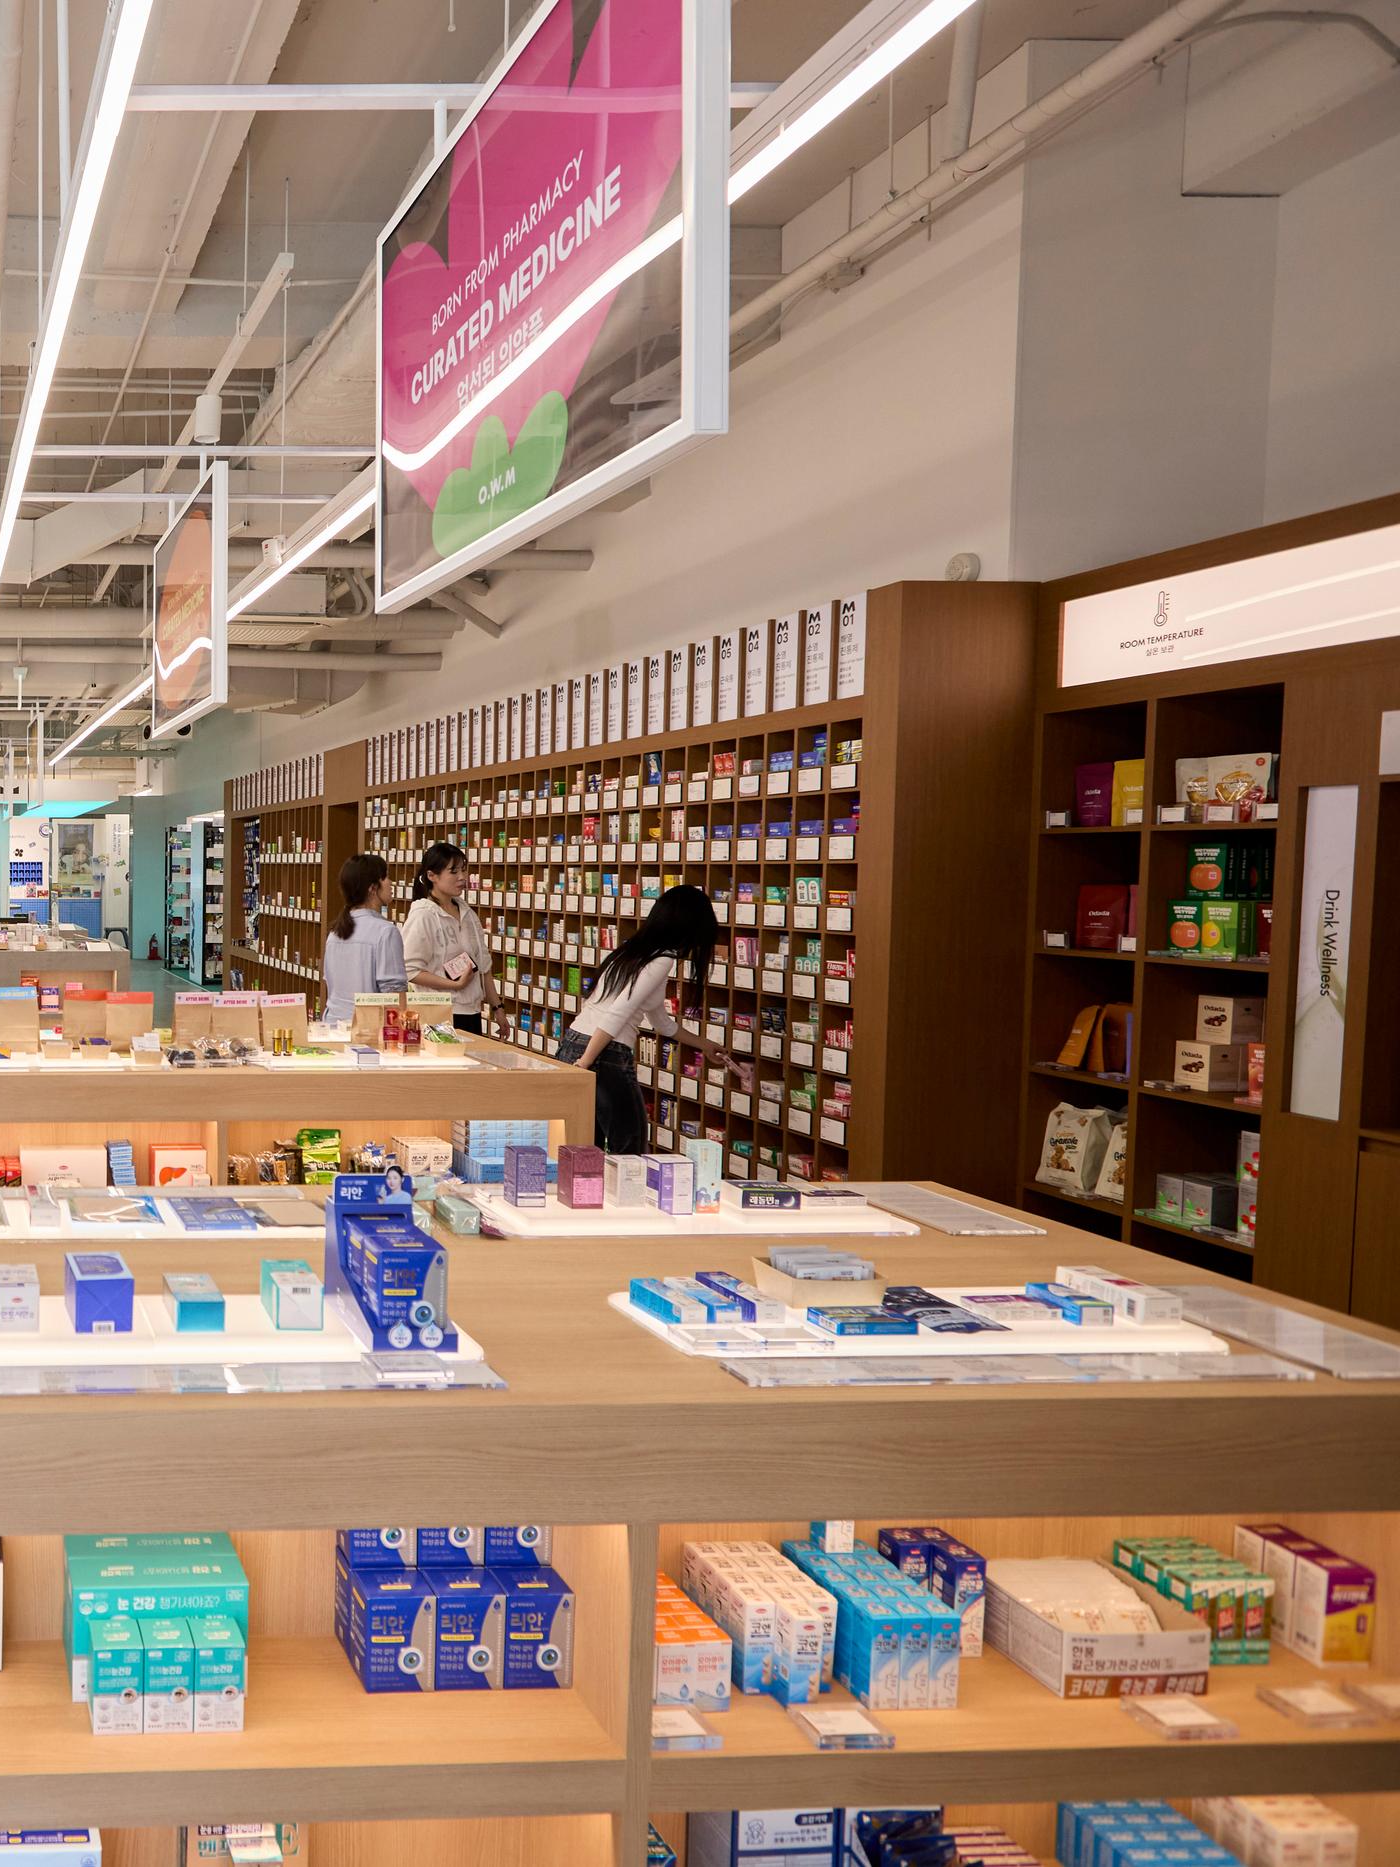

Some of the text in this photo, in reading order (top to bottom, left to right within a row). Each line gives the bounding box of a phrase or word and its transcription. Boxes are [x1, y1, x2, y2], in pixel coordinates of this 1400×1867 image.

[431, 149, 585, 335] BORN FROM PHARMACY
[411, 164, 623, 406] CURATED MEDICINE
[455, 354, 496, 411] 엄선된
[477, 465, 517, 505] O.W.M
[842, 601, 855, 615] M
[808, 611, 821, 624] M
[842, 614, 854, 627] 01
[777, 621, 789, 633] M
[808, 624, 820, 636] 02
[748, 630, 759, 641] M
[777, 632, 789, 645] 03
[1119, 627, 1204, 650] ROOM TEMPERATURE
[721, 638, 732, 649] M
[748, 641, 759, 653] 04
[696, 645, 706, 656] M
[721, 648, 732, 659] 05
[1145, 644, 1175, 657] 실온 보관
[673, 652, 682, 662] M
[696, 655, 706, 666] 06
[630, 665, 638, 674] M
[650, 659, 659, 669] M
[672, 662, 682, 673] 07
[610, 671, 618, 680] M
[629, 674, 638, 684] 09
[650, 668, 659, 679] 08
[573, 681, 582, 689] M
[591, 676, 599, 685] M
[610, 680, 617, 689] 10
[541, 691, 548, 699] M
[557, 686, 564, 694] M
[574, 690, 581, 699] 12
[592, 685, 598, 695] 11
[526, 695, 533, 703] M
[541, 699, 548, 707] 14
[557, 694, 564, 703] 13
[1320, 889, 1341, 997] Drink Wellness
[340, 1186, 364, 1200] 리안
[383, 1268, 418, 1287] 리안
[117, 1595, 221, 1610] 눈 건강 챙기셔야죠?
[371, 1615, 405, 1635] 리안
[440, 1613, 475, 1633] 리안
[510, 1612, 544, 1632] 리안
